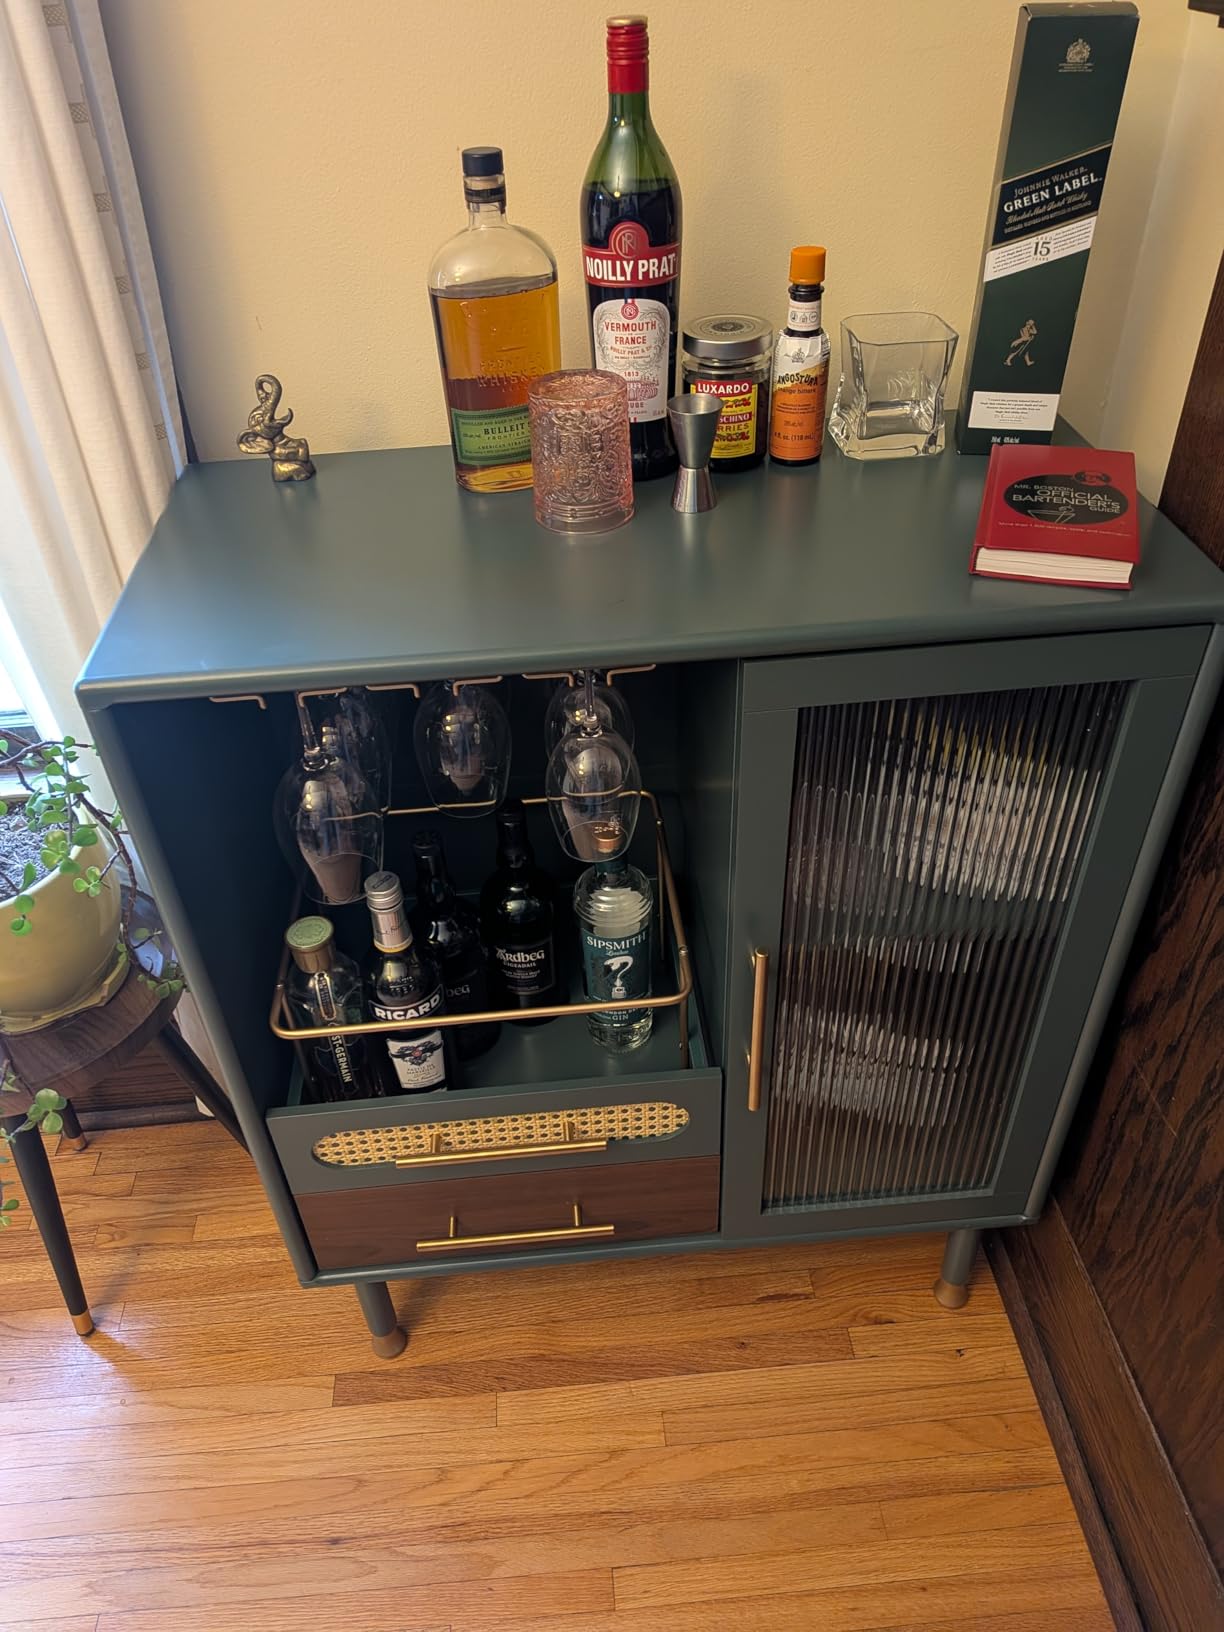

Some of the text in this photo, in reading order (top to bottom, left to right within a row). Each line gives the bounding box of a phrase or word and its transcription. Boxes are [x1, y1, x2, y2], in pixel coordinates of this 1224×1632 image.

[1014, 166, 1085, 198] JOHNNIE WALKER
[1003, 172, 1100, 213] GREEN LABEL
[1033, 241, 1051, 257] 15
[586, 253, 676, 281] NOILLY PRAT
[604, 320, 657, 333] VERMOUTH
[614, 335, 647, 345] FRANCE
[777, 372, 818, 387] ANGOSTURA
[698, 383, 750, 395] LUXARDO
[484, 422, 525, 435] BULLEIT
[717, 423, 750, 432] RRIES
[1012, 494, 1121, 509] BARTENDER'S
[1037, 490, 1112, 501] OFFICIAL
[587, 931, 647, 951] SIPSMITH
[374, 993, 441, 1021] RICARD
[331, 1035, 353, 1084] ST-GERMAIN
